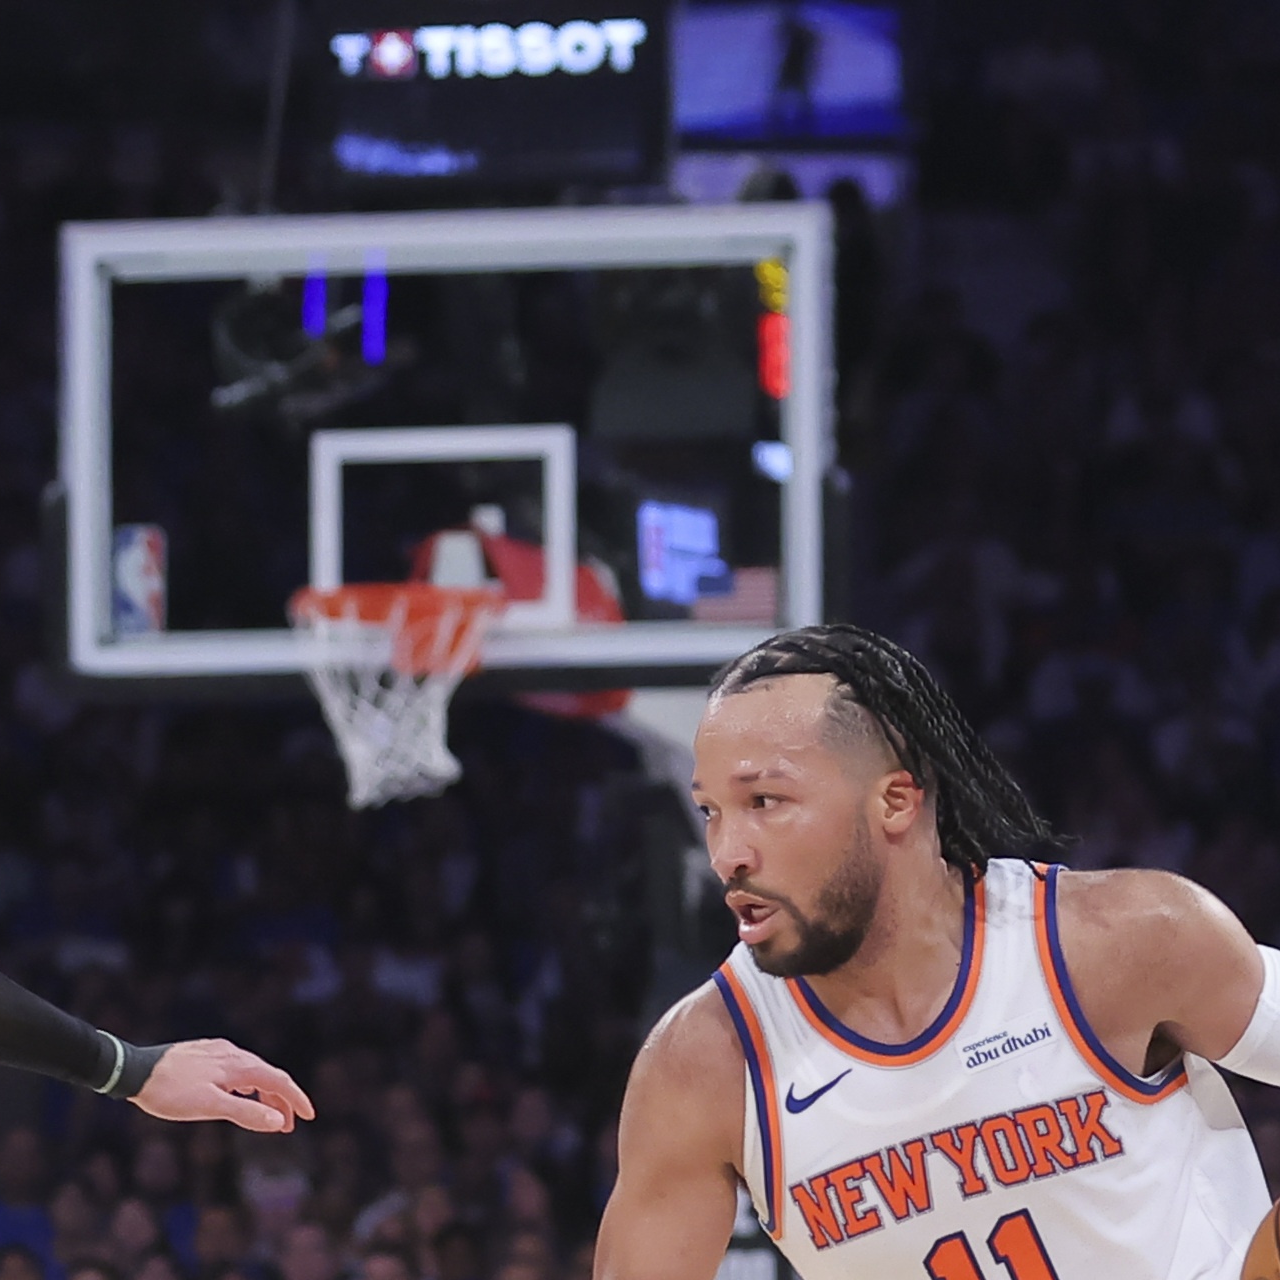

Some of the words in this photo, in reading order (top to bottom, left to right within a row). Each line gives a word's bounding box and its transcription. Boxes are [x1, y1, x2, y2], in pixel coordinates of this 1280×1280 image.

[415, 19, 647, 79] TISSOT
[962, 1030, 1008, 1053] experience
[966, 1047, 1001, 1069] abu
[1001, 1021, 1052, 1055] dhabi
[789, 1132, 934, 1252] NEW
[933, 1086, 1125, 1201] YORK
